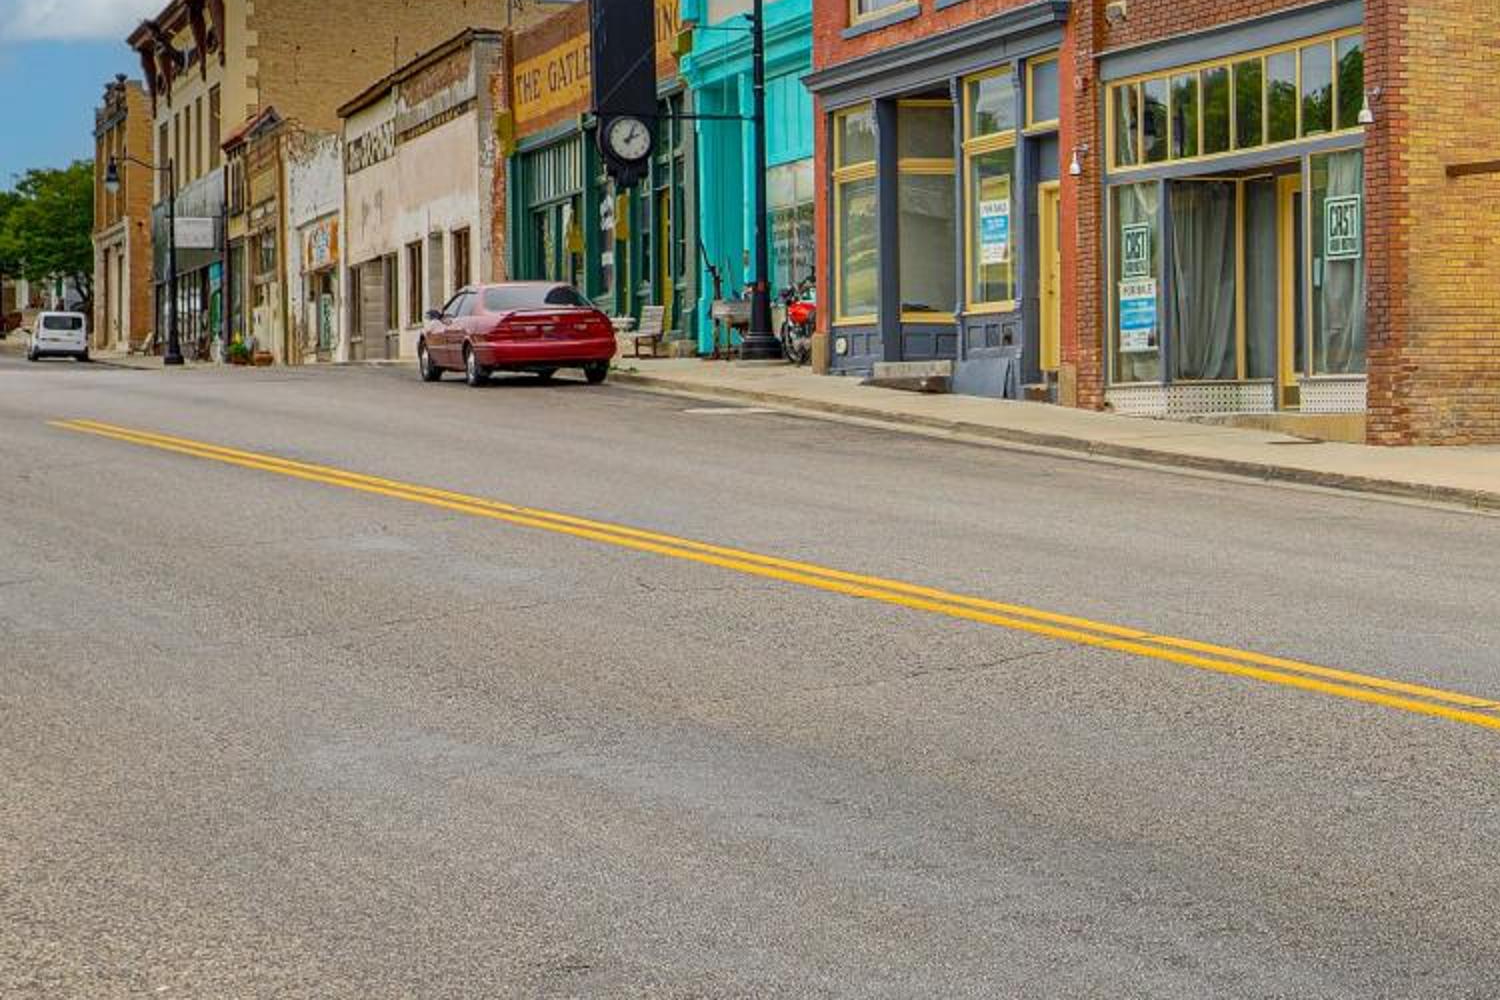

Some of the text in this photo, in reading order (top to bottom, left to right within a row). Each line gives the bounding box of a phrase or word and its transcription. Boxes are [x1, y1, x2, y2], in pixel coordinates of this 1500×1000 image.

[515, 69, 541, 105] THE
[548, 45, 590, 92] GATLE
[1331, 204, 1355, 236] CAST
[1125, 231, 1146, 260] CAST
